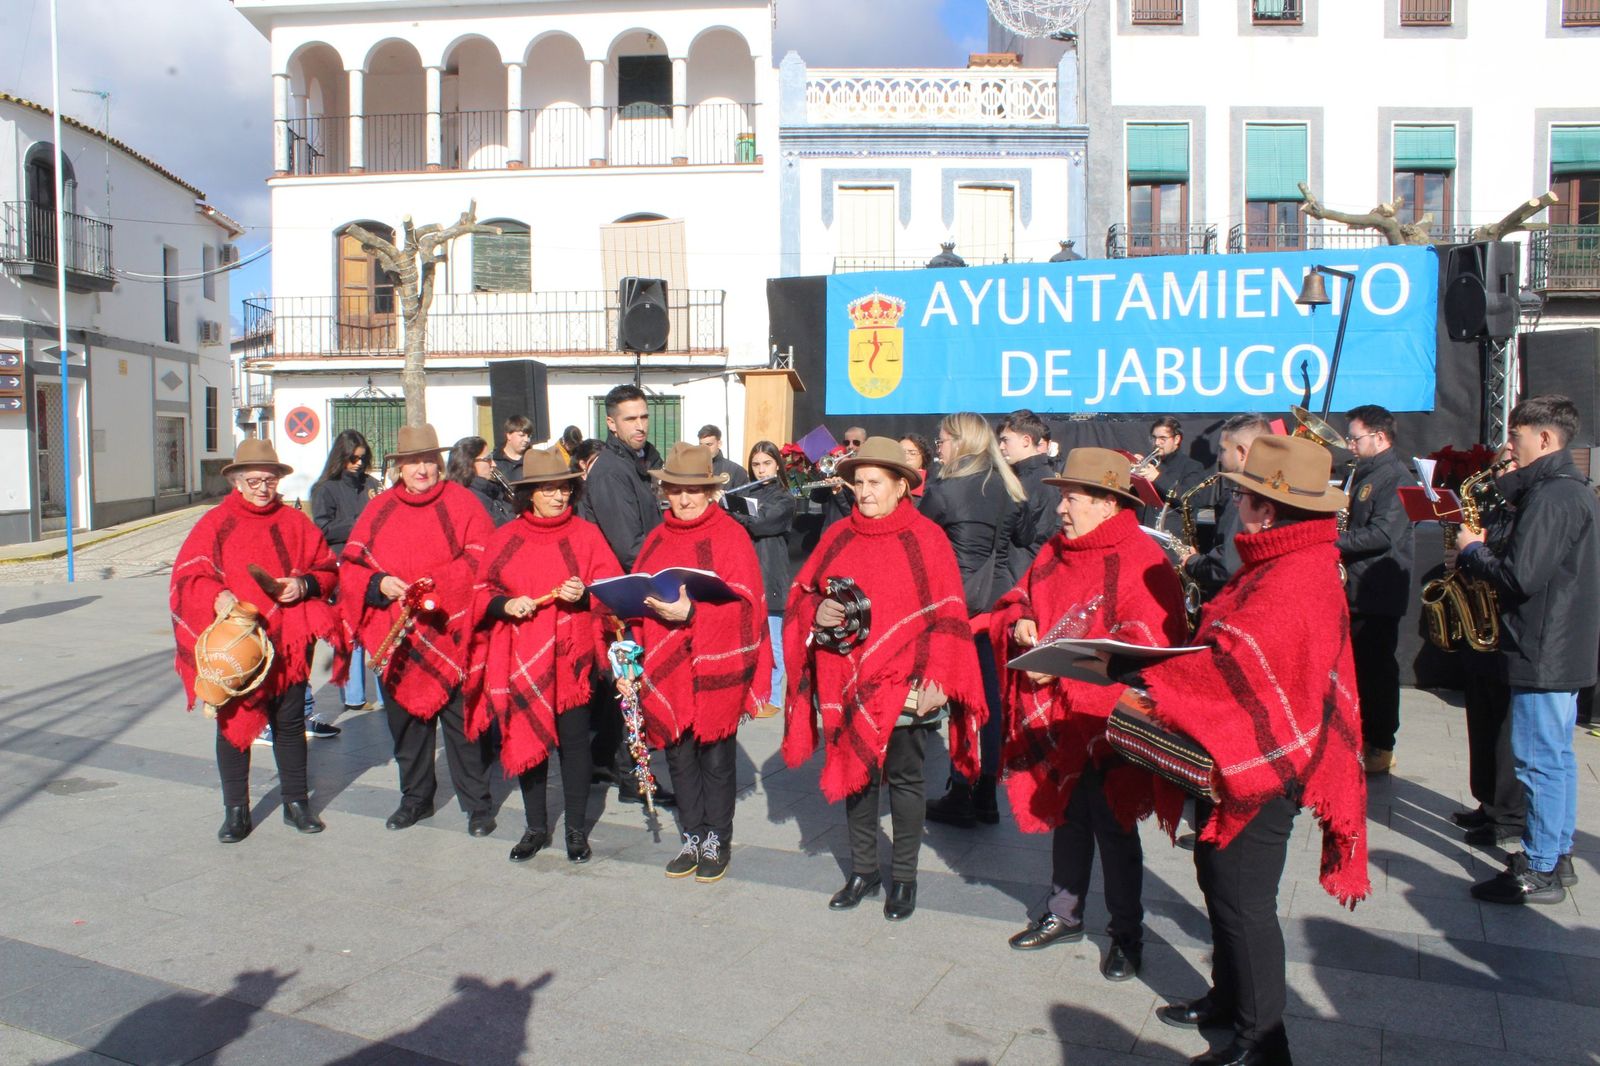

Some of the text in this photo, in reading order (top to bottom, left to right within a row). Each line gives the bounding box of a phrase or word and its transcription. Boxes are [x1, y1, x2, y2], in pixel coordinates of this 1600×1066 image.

[920, 262, 1410, 327] AYUNTAMIENTO
[1001, 343, 1329, 405] DE JABUGO
